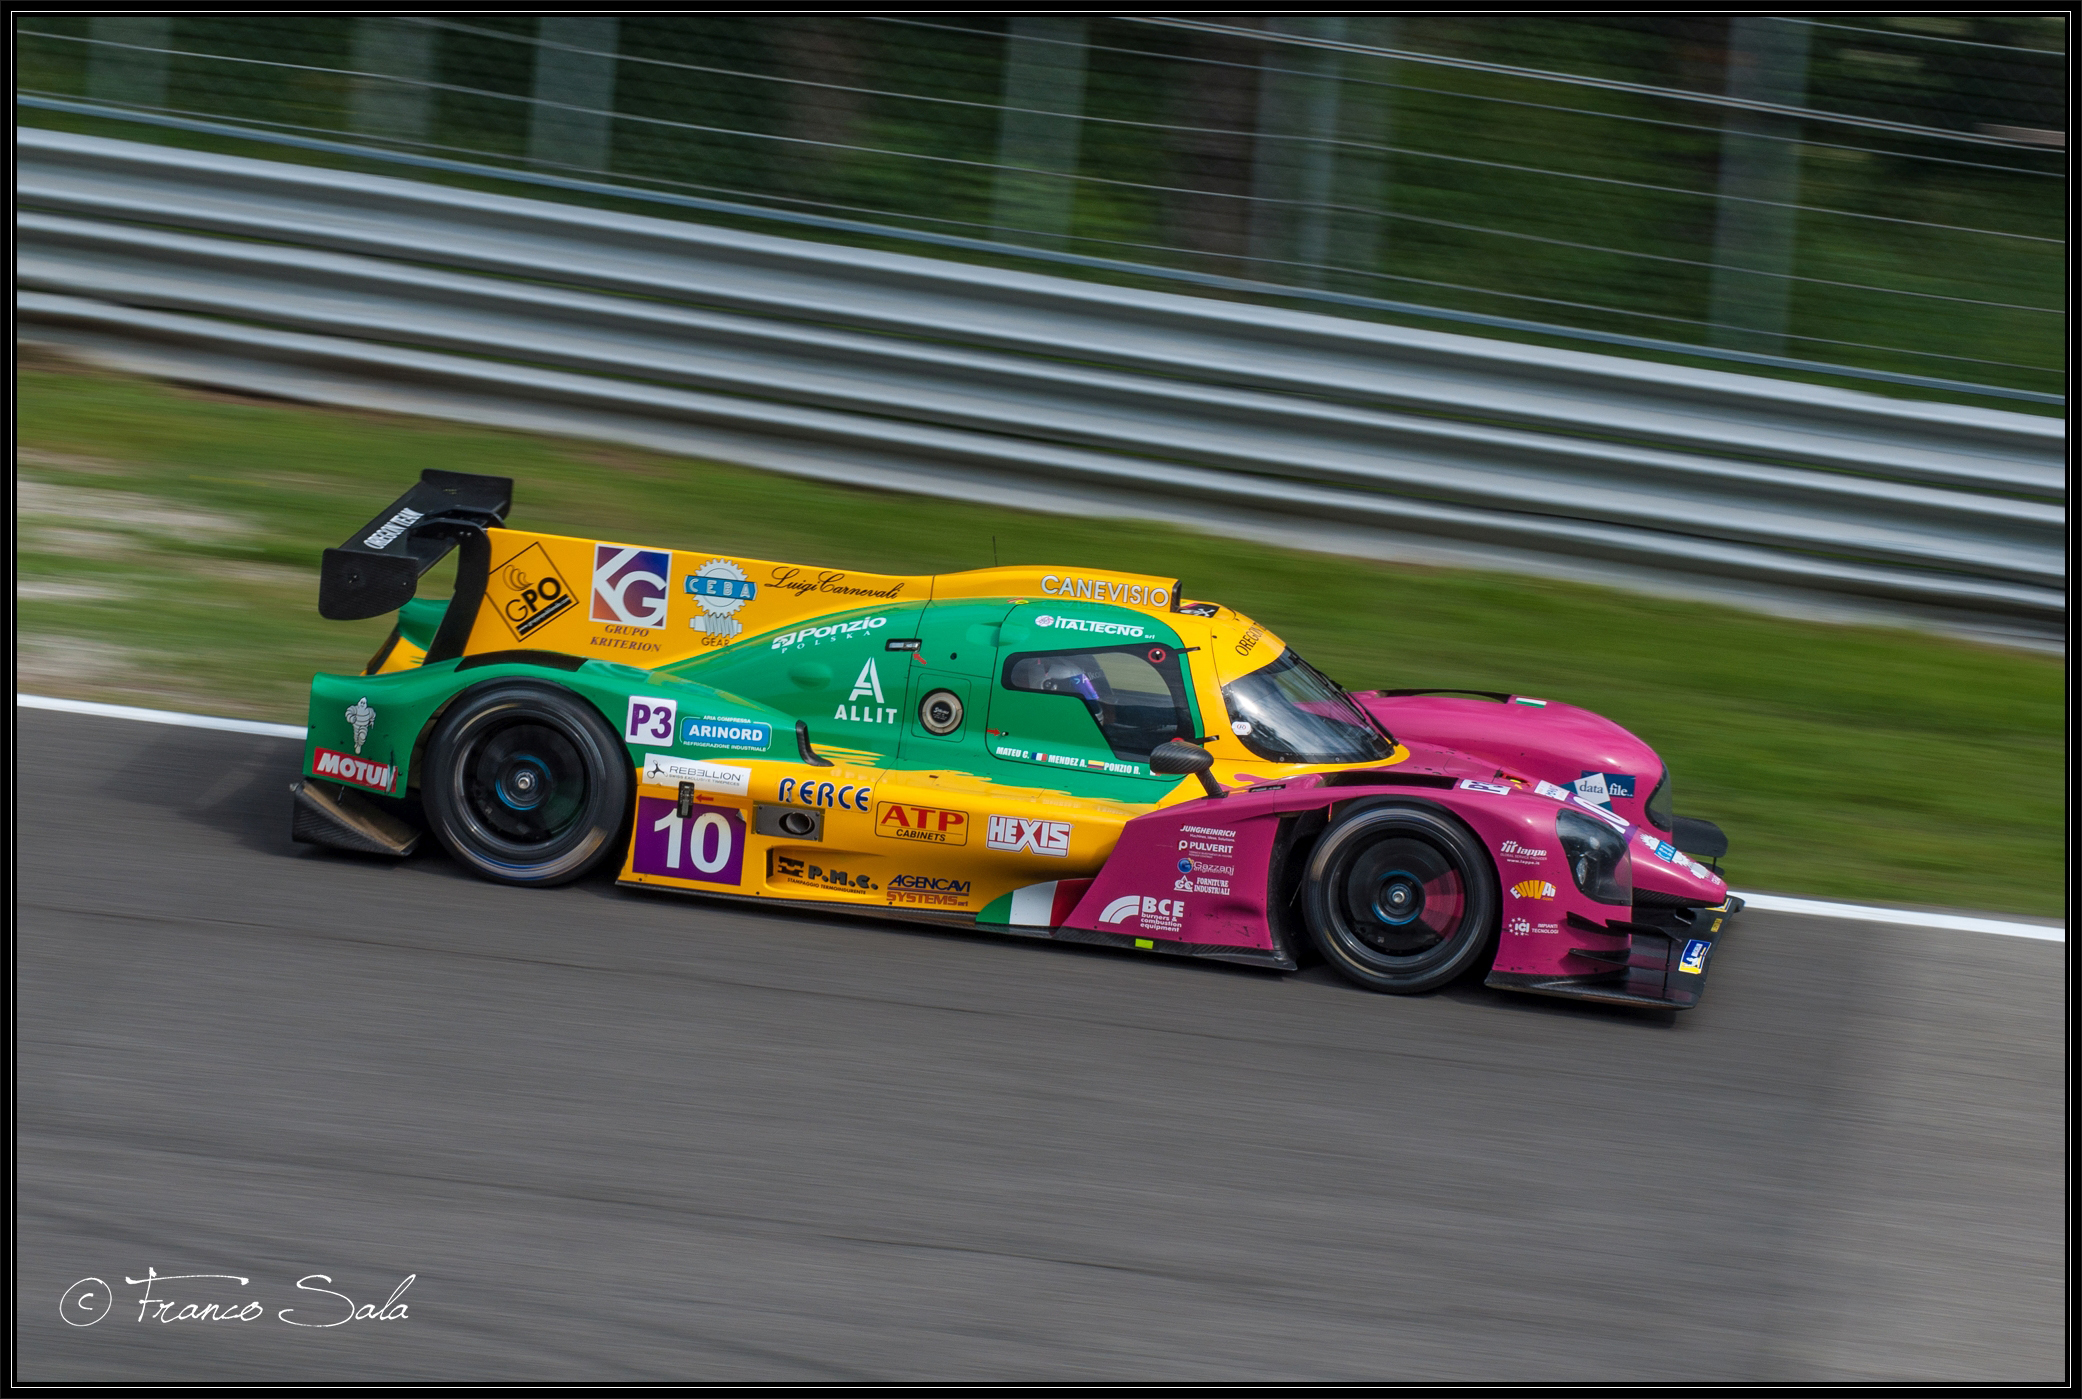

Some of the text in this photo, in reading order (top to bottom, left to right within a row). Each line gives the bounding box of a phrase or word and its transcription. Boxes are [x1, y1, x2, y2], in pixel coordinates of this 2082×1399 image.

[363, 507, 425, 550] OREGON TEAM
[689, 578, 751, 599] CEBA
[764, 566, 905, 600] Luigi Carnevali
[1040, 574, 1170, 608] CANEVISIO
[505, 576, 562, 623] GPO
[604, 624, 649, 638] GRUPO
[797, 616, 888, 643] Ponzio
[590, 636, 662, 653] KRITERION
[701, 637, 730, 648] GEAR
[1234, 624, 1264, 657] OREGON
[629, 703, 672, 740] P3
[717, 716, 751, 724] COMPRESSA
[833, 704, 898, 724] ALLIT
[688, 724, 763, 742] ARINORD
[683, 740, 767, 753] REFRIGERAZIONE INDUSTRIALE
[995, 746, 1030, 760] MATEU C.
[1048, 754, 1087, 768] MENDEZ A.
[1103, 762, 1141, 775] PONZIO R.
[684, 775, 712, 783] EXCLUSIVE
[712, 779, 740, 787] TIMEPIECES
[1580, 780, 1604, 794] data
[1609, 782, 1628, 796] file
[881, 804, 965, 832] ATP
[896, 828, 946, 842] CABINETS
[988, 816, 1072, 854] HEXIS
[1179, 825, 1237, 838] JUNGHEINRICH
[653, 808, 732, 874] 10
[1189, 841, 1233, 854] PULVERIT
[807, 864, 879, 891] P.M.C.
[888, 874, 971, 893] AGENCAVI
[1196, 877, 1229, 888] FORNITURE
[787, 877, 867, 895] STAMPAGGIO TERMOINDURENTE
[1193, 885, 1230, 896] INDUSTRIALI
[886, 891, 958, 906] SYSTEMS
[1142, 896, 1185, 918] BCE
[1140, 918, 1182, 928] combustion
[1141, 912, 1170, 921] burners
[1140, 923, 1180, 932] equipment
[1514, 923, 1530, 933] ICI
